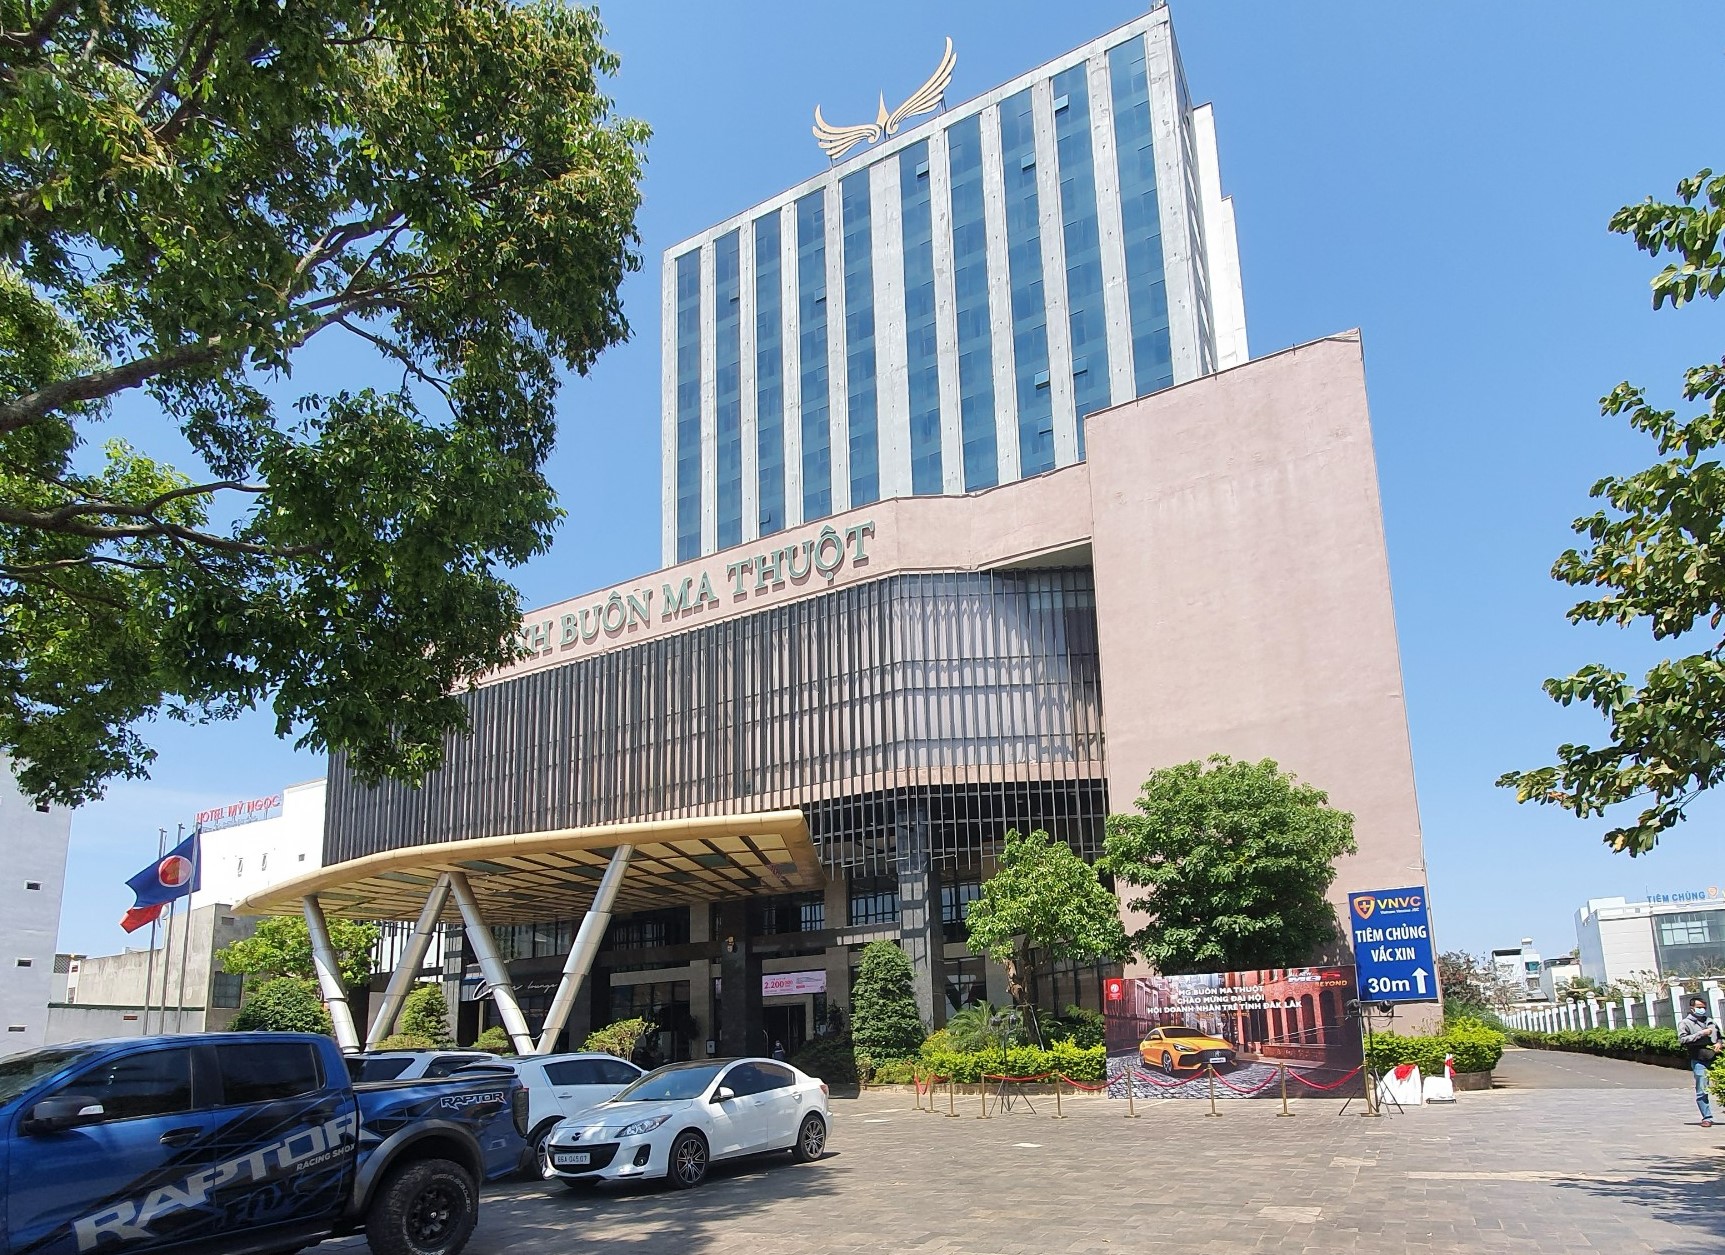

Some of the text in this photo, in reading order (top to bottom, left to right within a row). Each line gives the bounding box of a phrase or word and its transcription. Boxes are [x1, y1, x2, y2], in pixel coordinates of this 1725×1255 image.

[559, 590, 653, 647] BUÔN
[660, 571, 718, 616] MA
[726, 520, 875, 595] THUỘT
[196, 807, 225, 823] HOTEL
[1377, 896, 1421, 909] VNVC
[1647, 893, 1669, 903] TIÊM
[1355, 923, 1427, 943] TIÊM CHỦNG
[1394, 946, 1416, 961] XIN
[1233, 984, 1264, 993] THUỘT
[1368, 977, 1410, 993] 30m
[1248, 993, 1265, 1002] HỘI
[1164, 1006, 1195, 1014] DOANH
[440, 1091, 508, 1111] RAPTOR
[296, 1152, 331, 1171] RACING
[74, 1111, 379, 1251] RAPTOR
